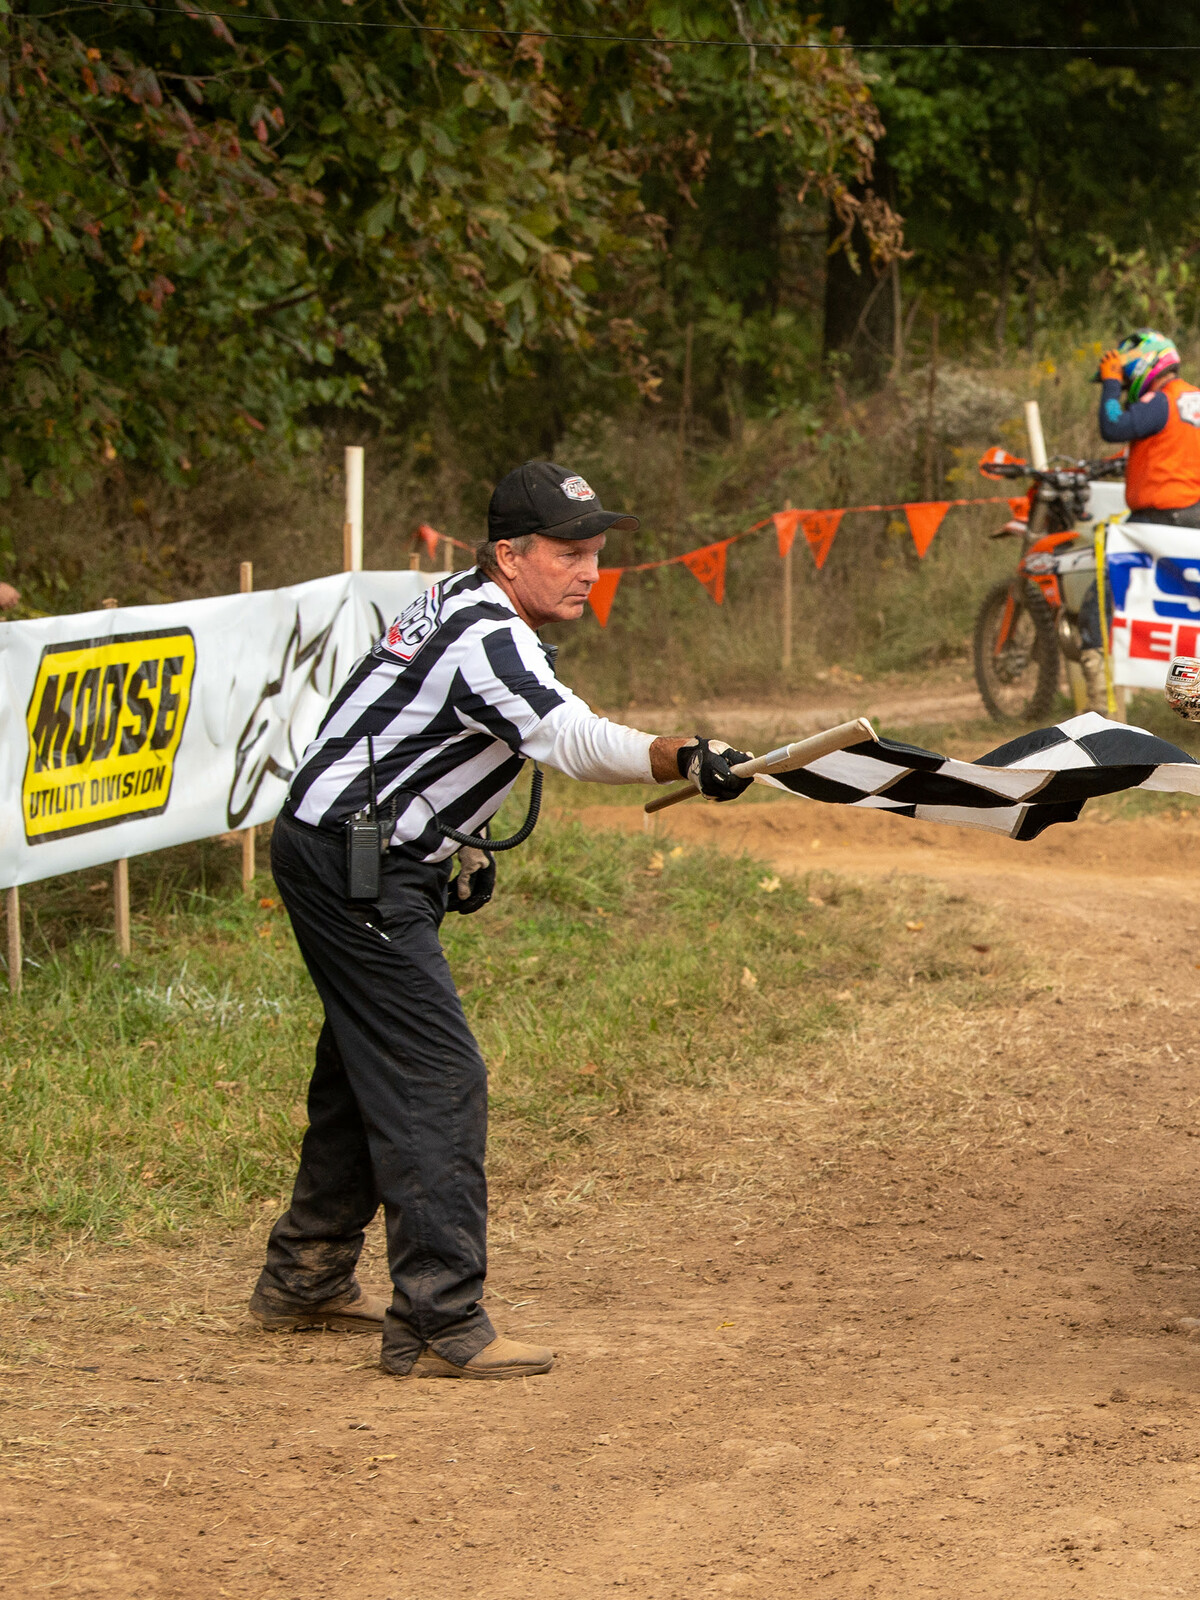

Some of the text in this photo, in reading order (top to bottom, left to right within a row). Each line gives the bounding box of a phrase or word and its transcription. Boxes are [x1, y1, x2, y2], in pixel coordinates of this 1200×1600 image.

[32, 655, 185, 774] MOOSE
[30, 765, 166, 820] UTILITY DIVISION
